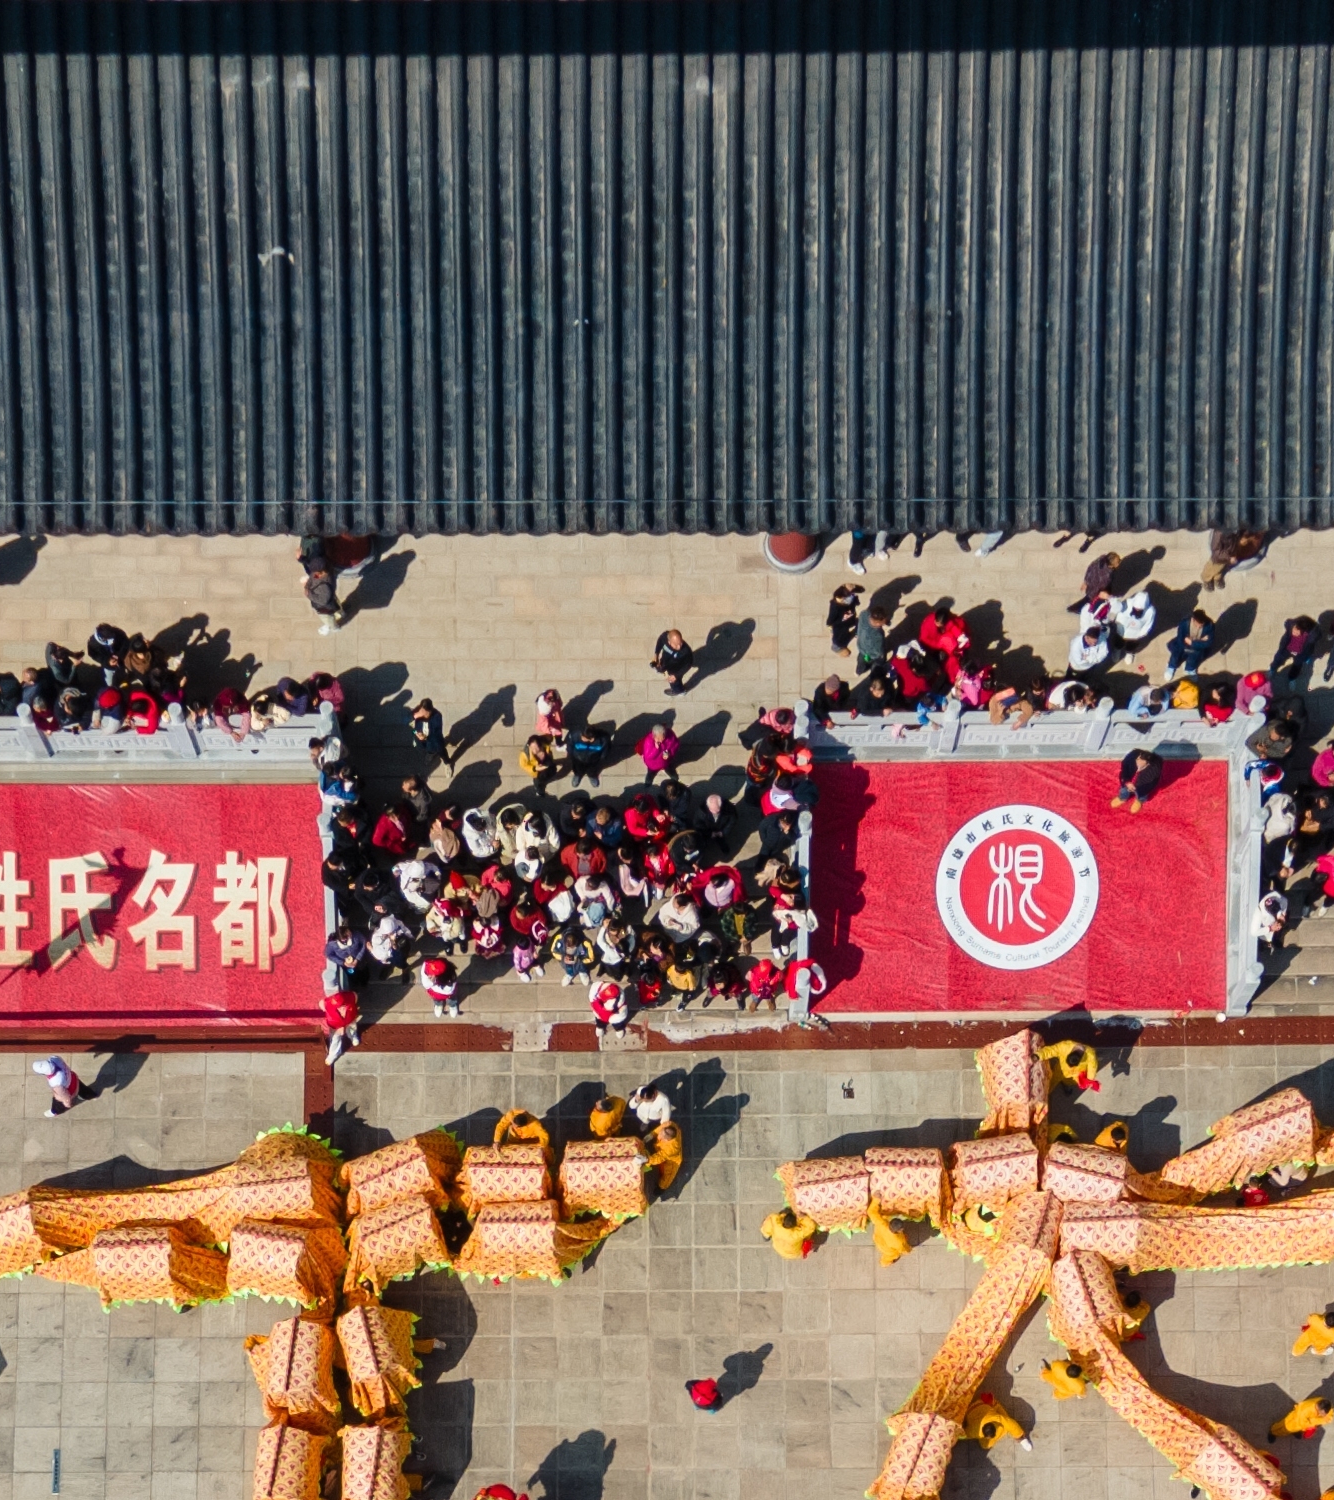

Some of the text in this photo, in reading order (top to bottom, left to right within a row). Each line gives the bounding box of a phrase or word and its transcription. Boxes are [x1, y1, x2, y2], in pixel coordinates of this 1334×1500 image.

[945, 812, 1091, 880] 南雄市姓氏文化旅游节
[945, 895, 1091, 962] Nanxiong Surname Cultural Tourism Festival
